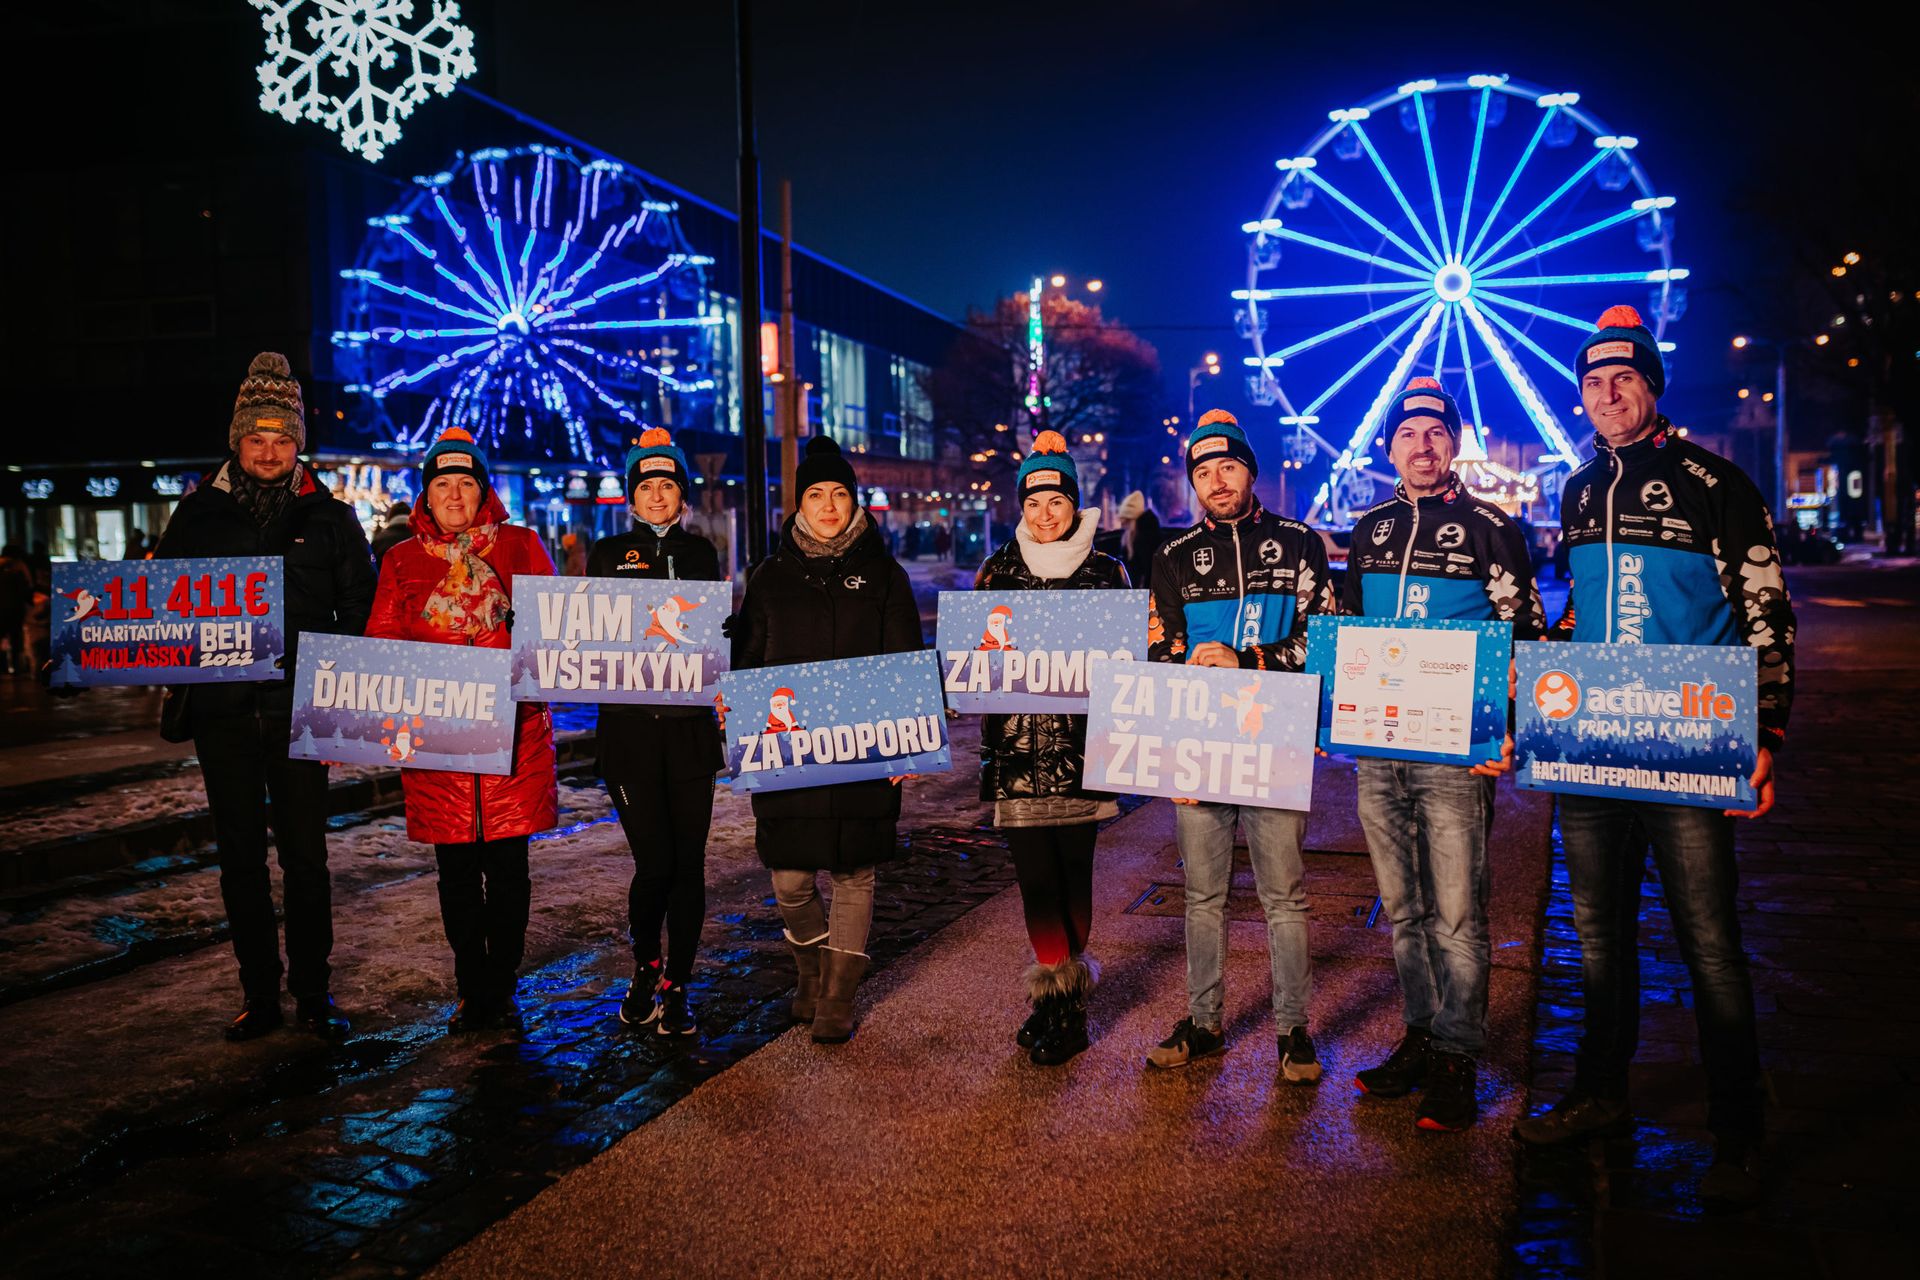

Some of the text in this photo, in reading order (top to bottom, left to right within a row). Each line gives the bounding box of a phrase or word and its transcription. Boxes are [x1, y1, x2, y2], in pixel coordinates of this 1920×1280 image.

[1681, 458, 1719, 488] TEAM
[1278, 520, 1309, 534] TEAM
[1473, 506, 1505, 528] TEAM
[1163, 527, 1203, 556] SLOVAKIA
[616, 562, 650, 571] activelife
[103, 572, 270, 620] 11 411€
[537, 581, 633, 642] VÁM
[200, 621, 253, 652] BEH
[199, 651, 254, 669] 2022
[536, 639, 704, 693] VŠETKÝM
[944, 649, 1135, 693] ZA POM
[1419, 660, 1469, 673] GlobalLogic
[313, 660, 497, 721] ĎAKUJEME
[1111, 674, 1218, 729] ZA TO,
[1586, 681, 1736, 722] activelife
[738, 714, 942, 773] ZA PODPORU
[1634, 720, 1655, 738] SA
[1660, 721, 1672, 737] K
[1105, 718, 1273, 799] ŽE STE!
[1531, 760, 1737, 798] #ACTIVELIFEPRIDAJSAKNAM
